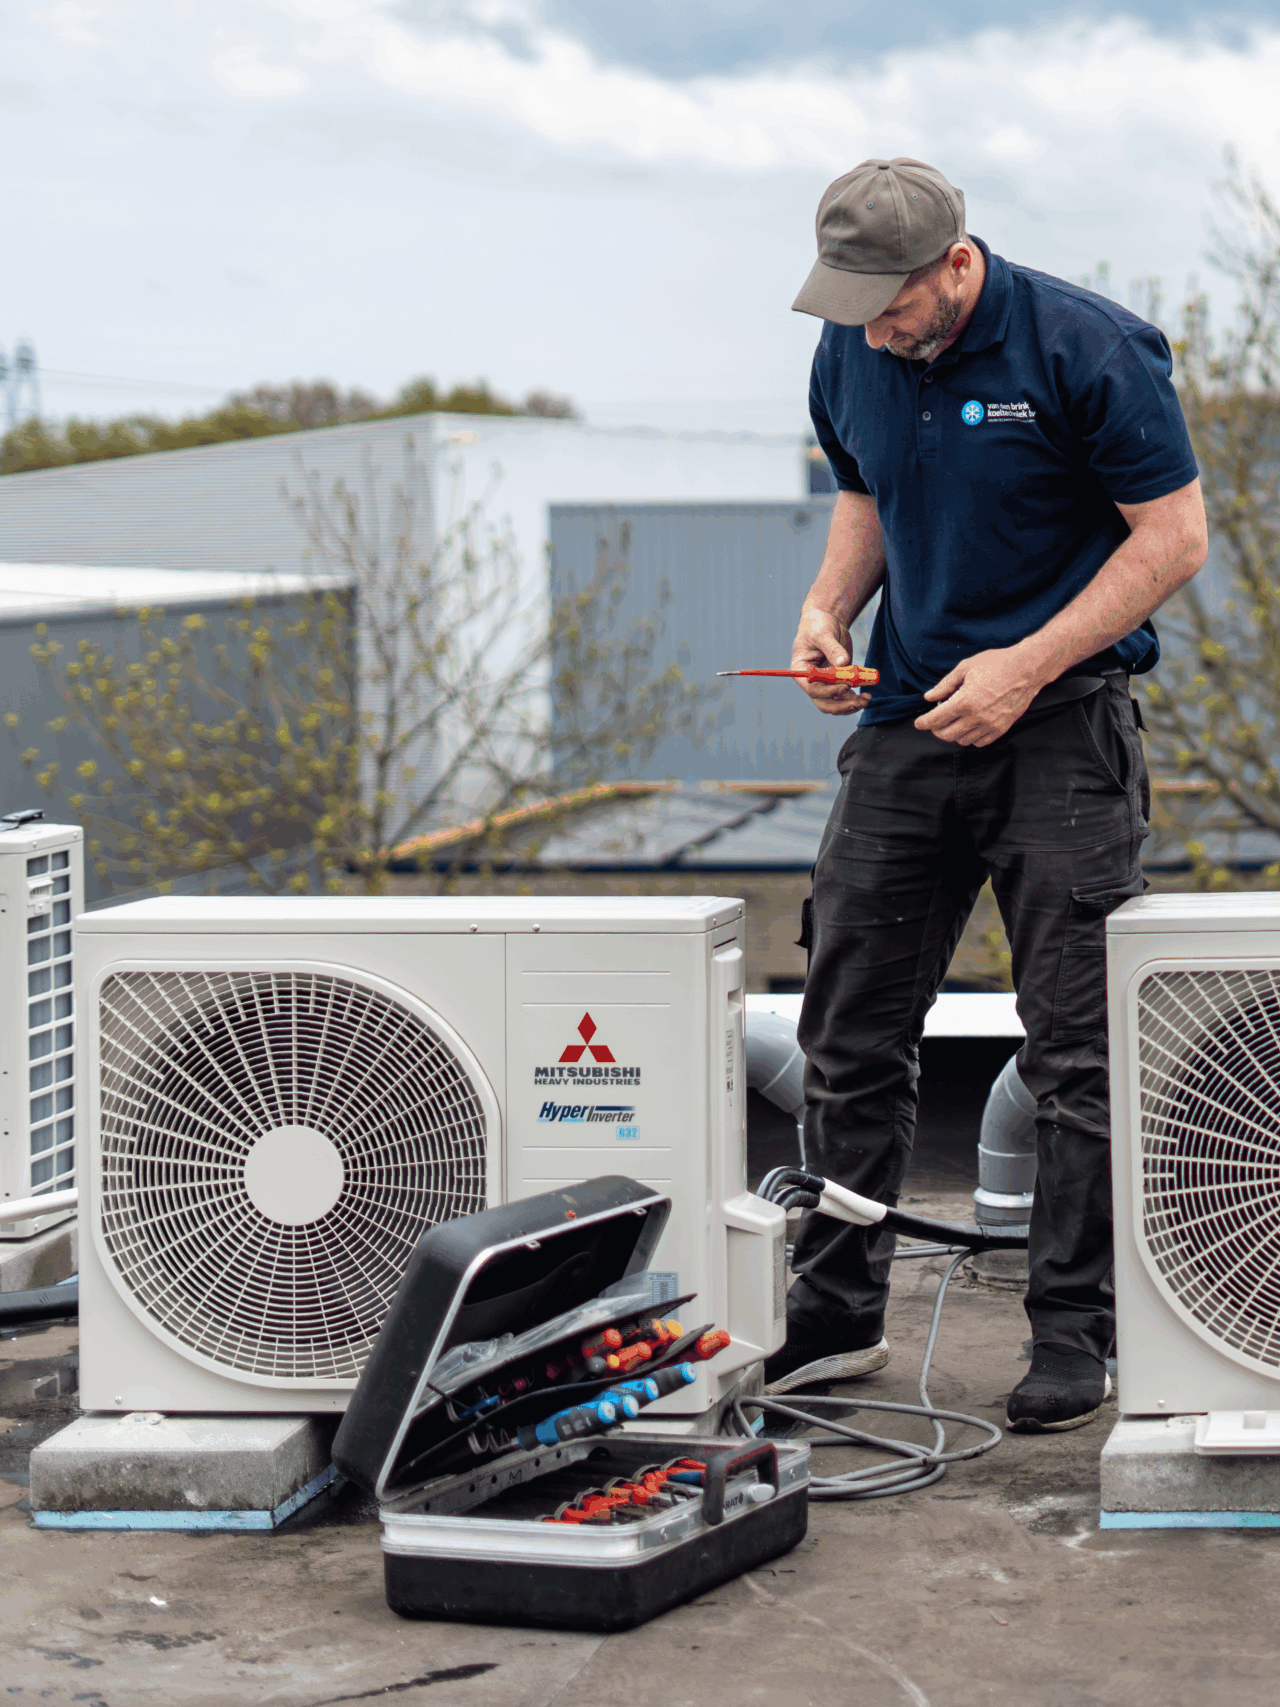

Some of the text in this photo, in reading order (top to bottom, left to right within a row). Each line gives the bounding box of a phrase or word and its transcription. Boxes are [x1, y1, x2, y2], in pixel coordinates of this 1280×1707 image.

[1011, 402, 1030, 410] brink
[534, 1066, 641, 1078] MITSUBISHI
[538, 1101, 635, 1122] Hyper Inverter
[618, 1127, 638, 1138] R32
